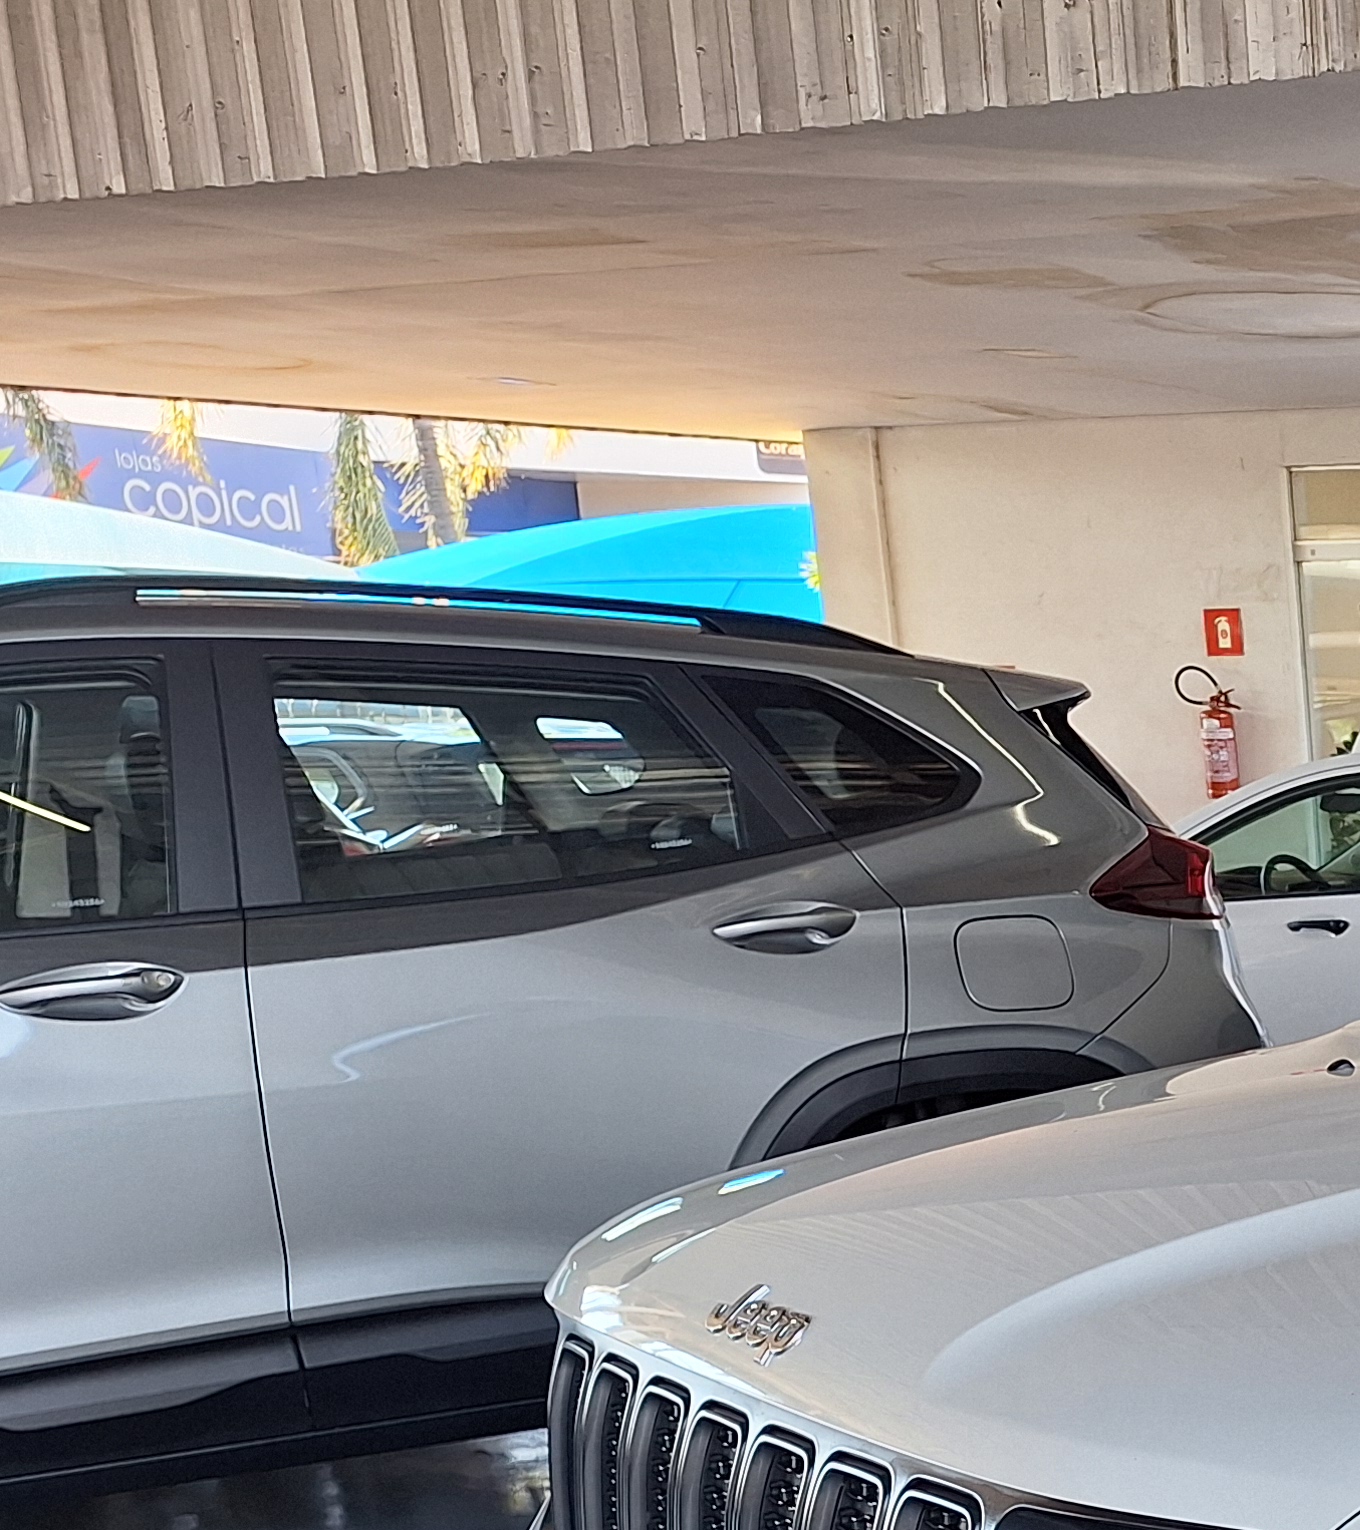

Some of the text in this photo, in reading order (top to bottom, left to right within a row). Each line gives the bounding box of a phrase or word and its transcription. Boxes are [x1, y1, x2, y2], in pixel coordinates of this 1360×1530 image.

[114, 448, 163, 473] lojas
[123, 477, 302, 533] copical
[704, 1283, 813, 1367] Jeep
